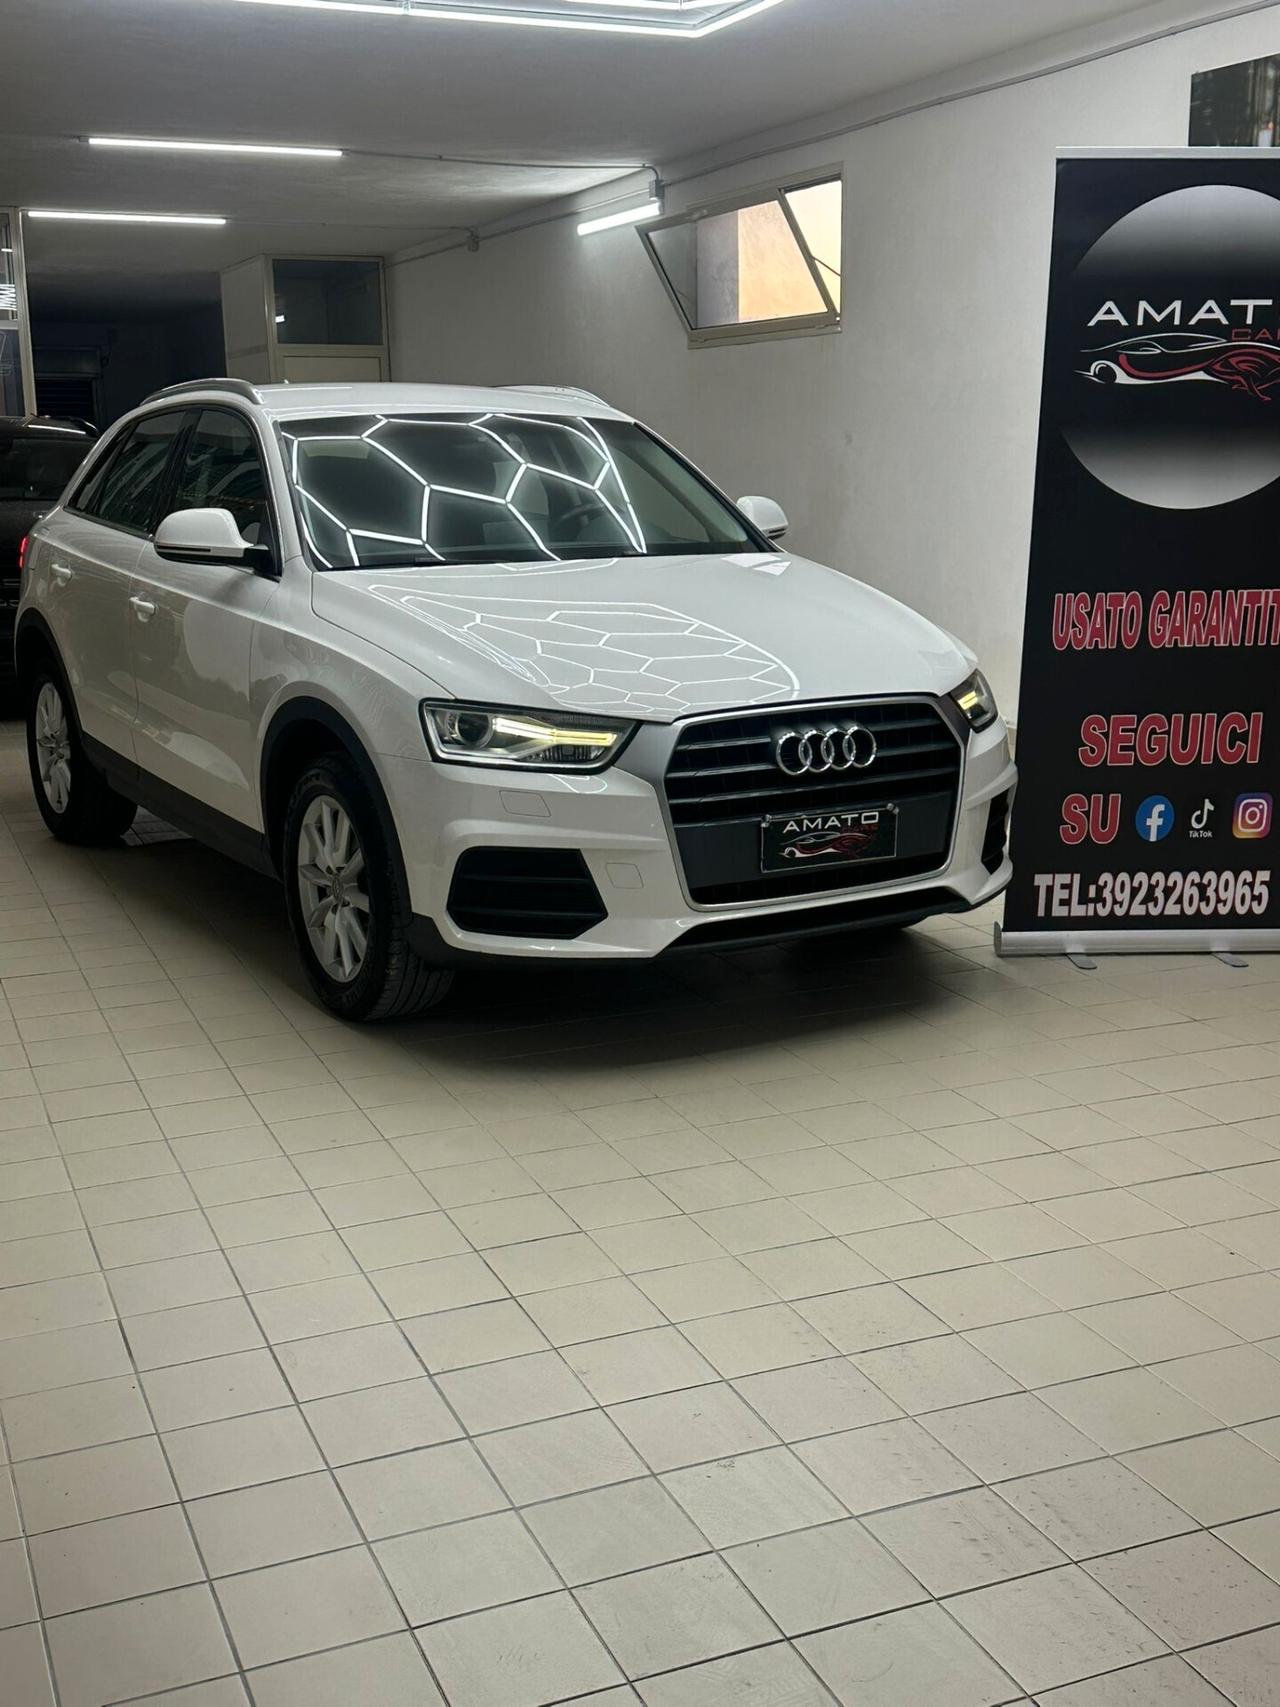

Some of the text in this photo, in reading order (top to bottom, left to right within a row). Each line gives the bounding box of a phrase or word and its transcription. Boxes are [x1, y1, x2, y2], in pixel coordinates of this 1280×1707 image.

[1052, 591, 1143, 650] USATO
[1078, 712, 1263, 767] SEGUICI
[782, 811, 879, 834] AMATO
[1059, 793, 1122, 845] SU
[1188, 830, 1213, 838] TikTok
[1034, 870, 1271, 917] TEL:3923263965
